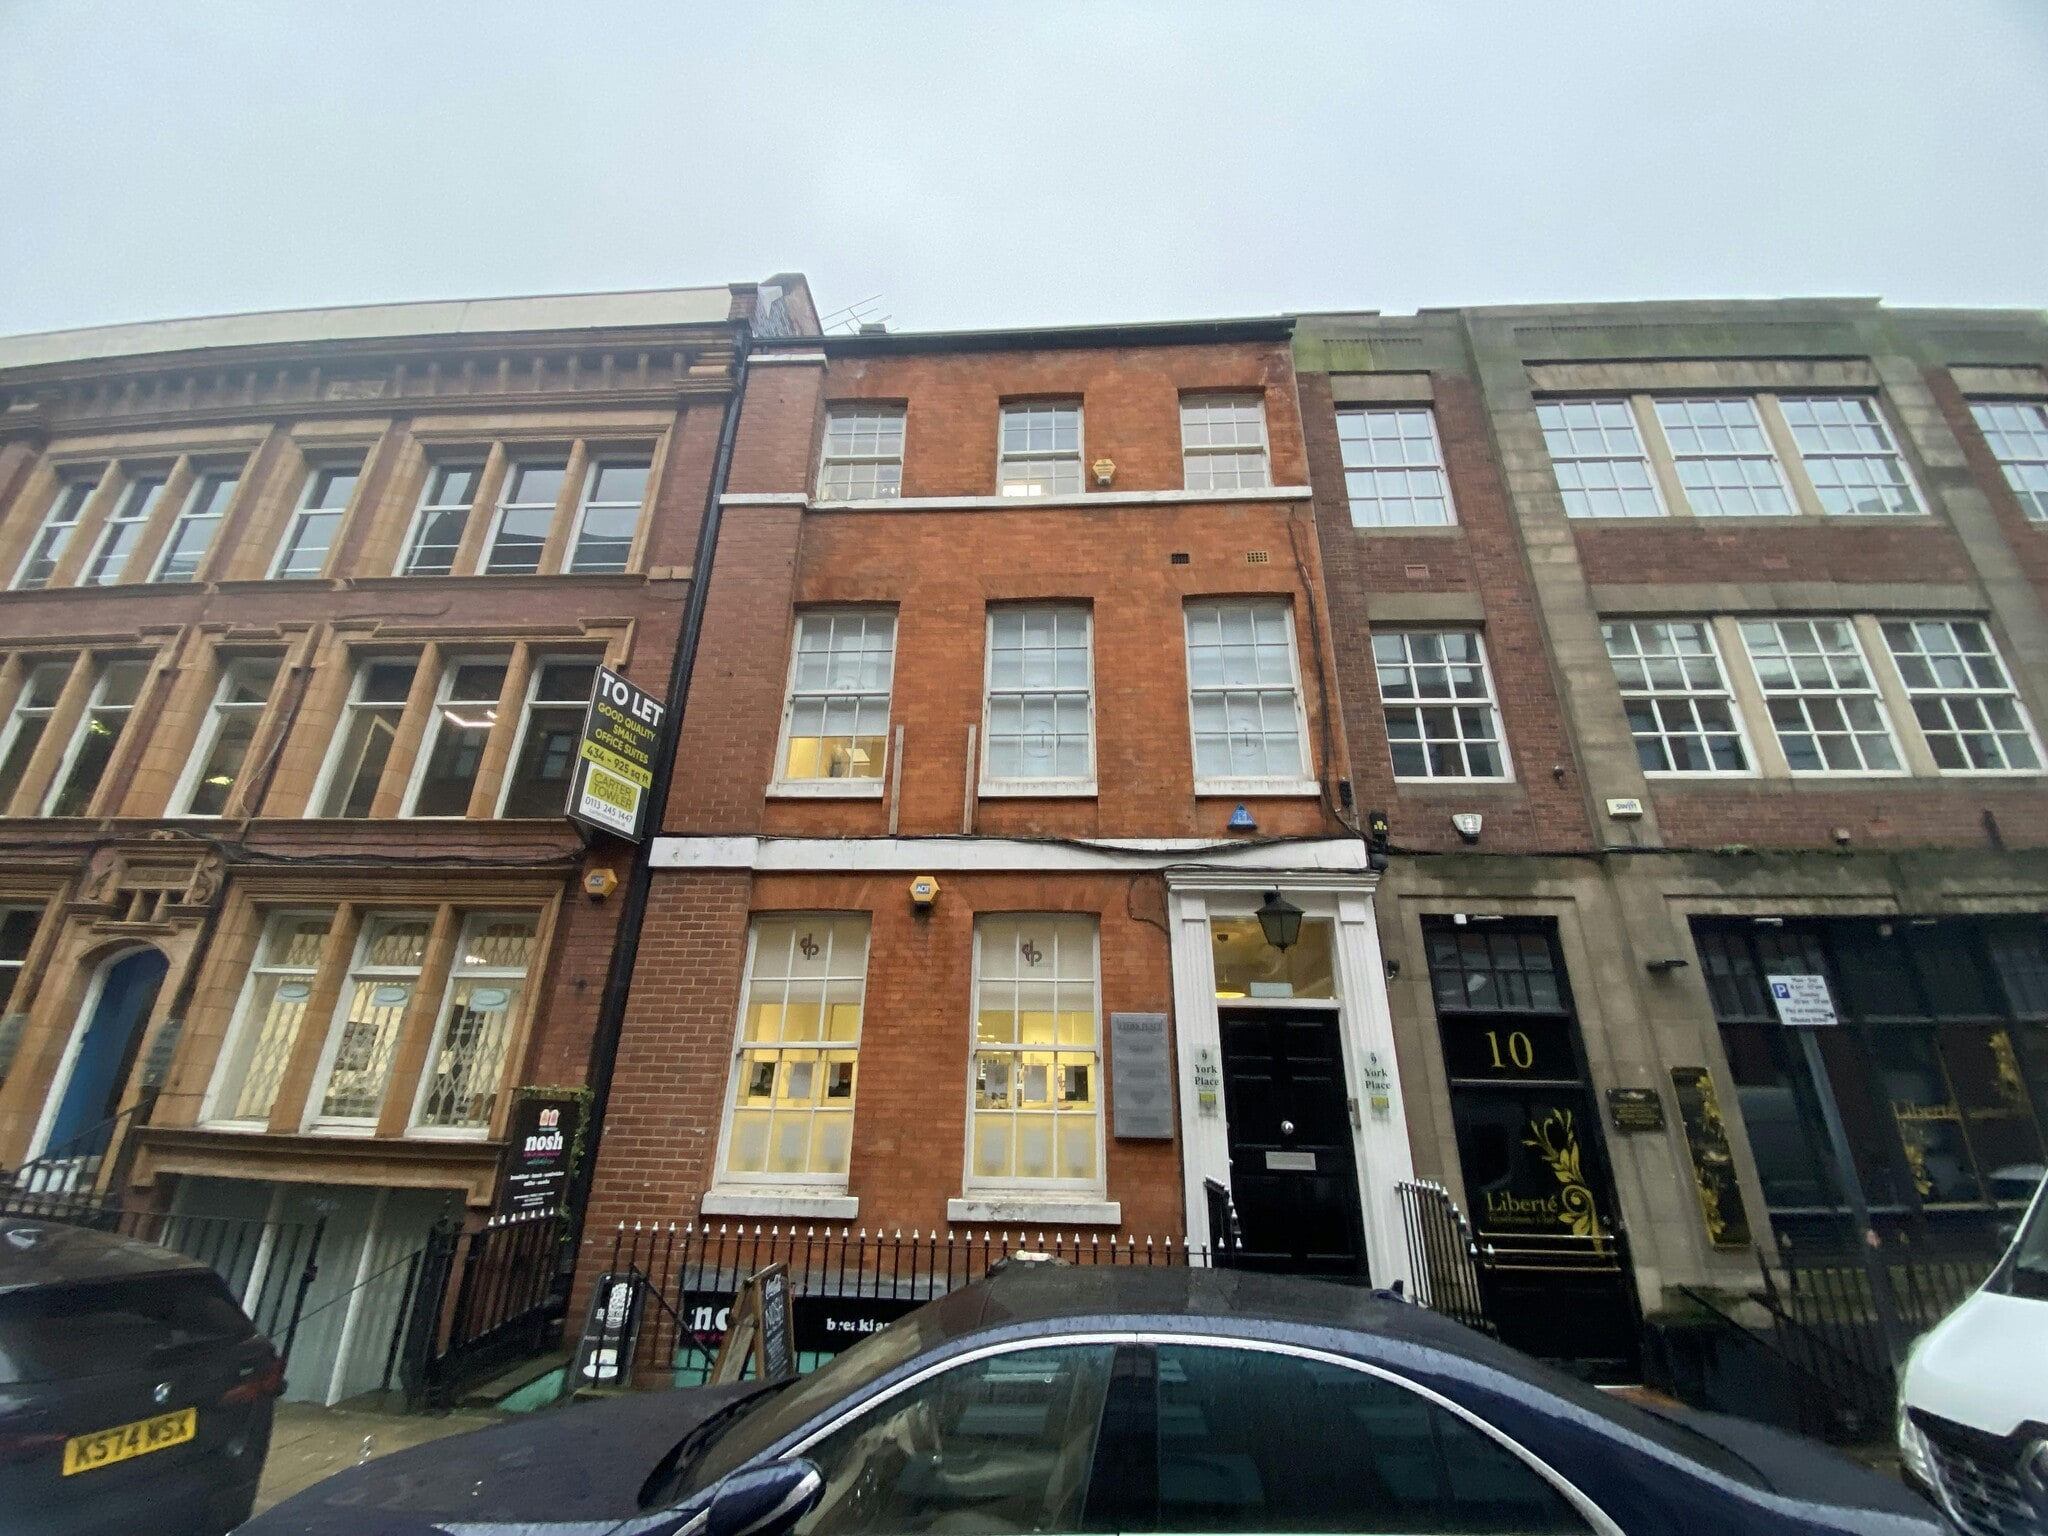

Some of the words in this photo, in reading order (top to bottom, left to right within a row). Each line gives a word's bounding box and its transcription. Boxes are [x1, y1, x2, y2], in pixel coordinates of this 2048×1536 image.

[602, 672, 628, 706] TO
[632, 692, 664, 727] LET
[598, 702, 624, 723] GOOD
[625, 718, 656, 742] QUALITY
[595, 728, 624, 751] OFFICE
[624, 744, 649, 765] SUITES
[613, 724, 637, 746] SMALL
[587, 745, 605, 762] 434
[614, 758, 629, 774] 925
[631, 769, 640, 782] sq
[642, 772, 649, 785] ft
[594, 772, 632, 797] CARTER
[594, 782, 632, 810] TOWLER
[585, 796, 601, 810] 0113
[603, 803, 616, 817] 245
[618, 809, 633, 823] 1447
[1485, 1031, 1533, 1068] 10
[1194, 1064, 1218, 1074] York
[1194, 1076, 1219, 1086] Place
[1364, 1068, 1388, 1077] York
[1365, 1080, 1391, 1089] Place
[524, 1131, 564, 1152] nosh
[1487, 1191, 1558, 1213] Liberté
